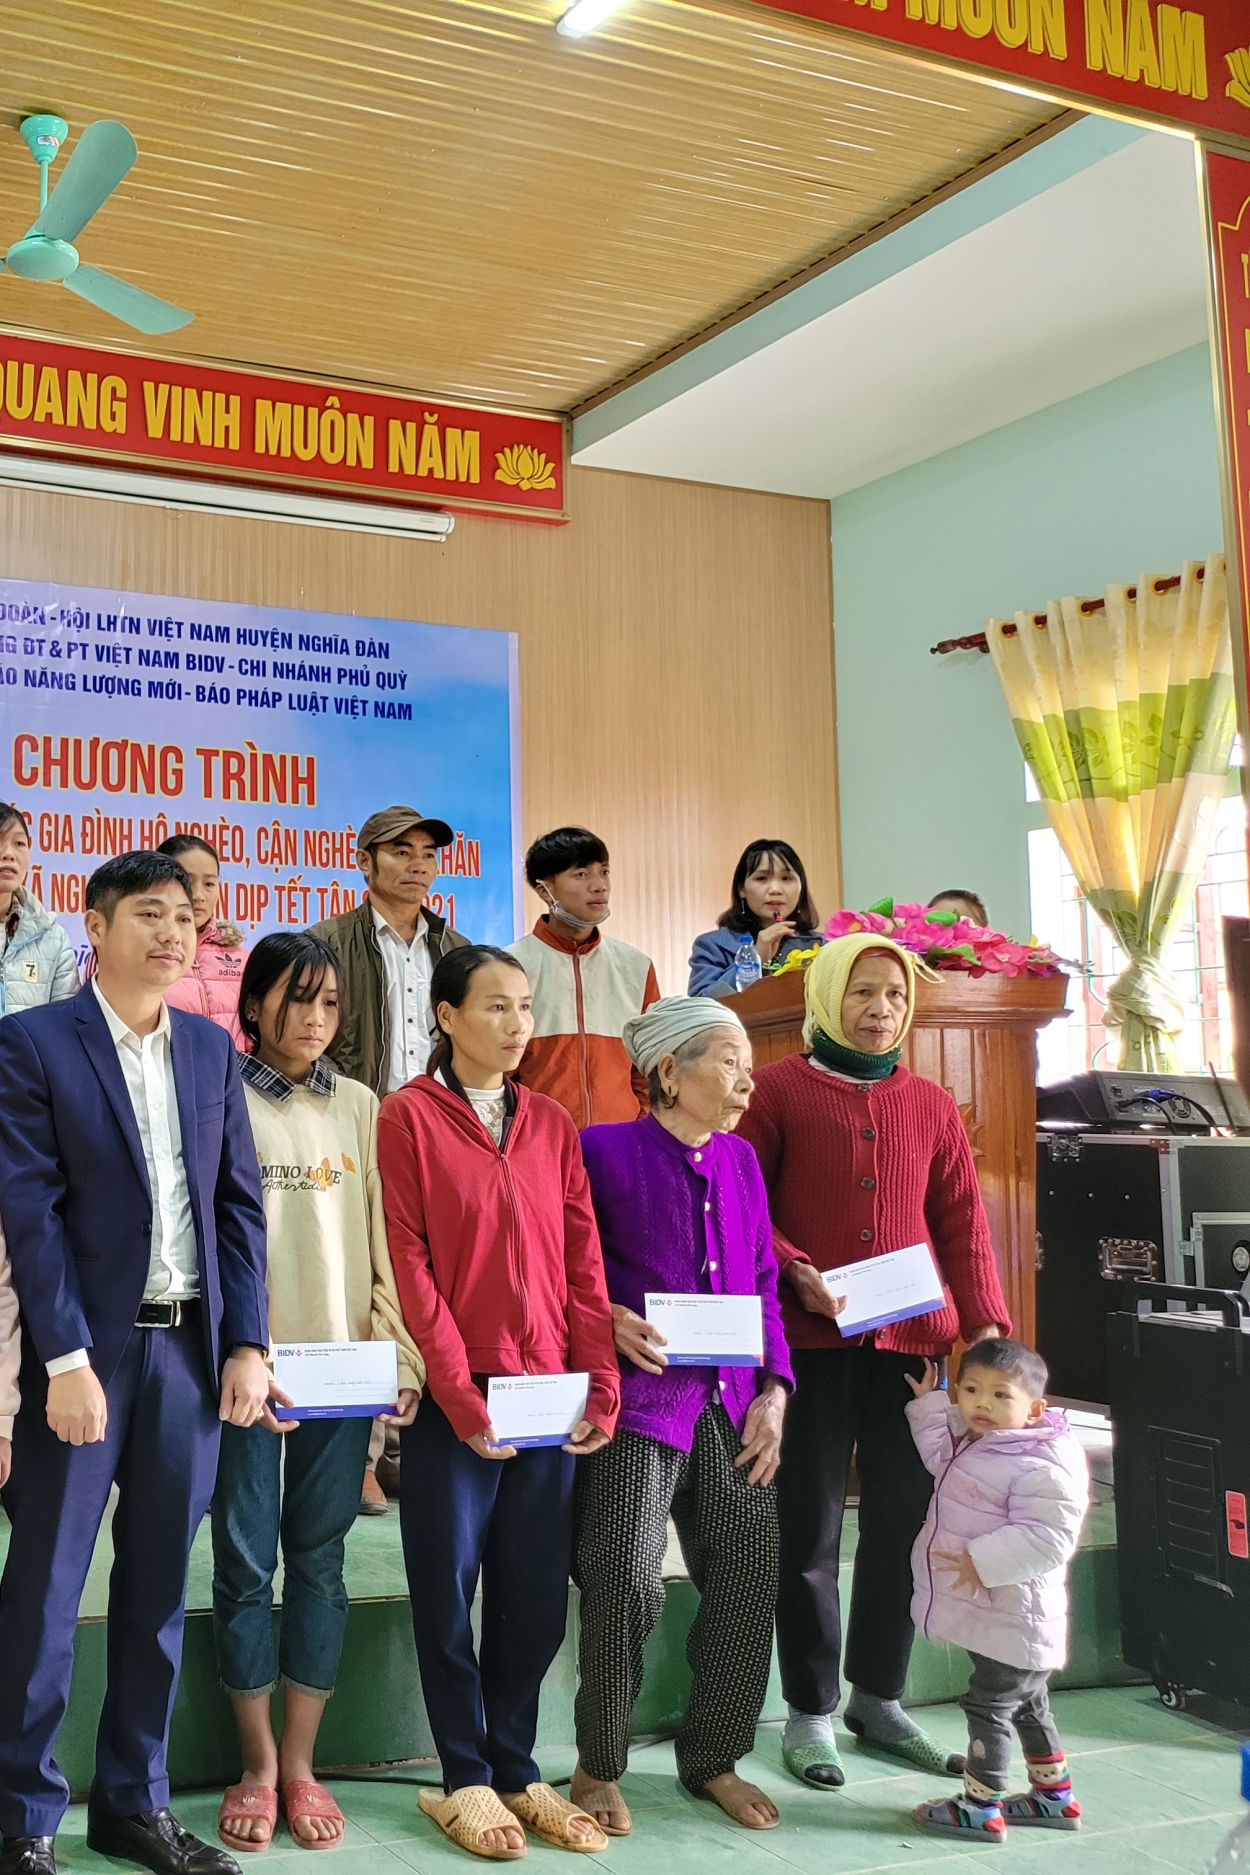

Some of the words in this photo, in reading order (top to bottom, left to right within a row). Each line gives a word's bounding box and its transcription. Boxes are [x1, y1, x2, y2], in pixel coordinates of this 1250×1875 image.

[142, 381, 241, 451] VINH
[254, 396, 374, 470] MUÔN
[387, 412, 481, 484] NĂM
[60, 607, 90, 632] HỘI
[97, 613, 140, 635] LHTN
[147, 617, 184, 642] VIỆT
[190, 622, 230, 644] NAM
[236, 627, 292, 652] HUYỆN
[298, 634, 350, 656] NGHĨA
[355, 637, 390, 660] ĐÀN
[49, 640, 63, 659] &
[66, 641, 89, 661] PT
[95, 643, 132, 668] VIỆT
[138, 648, 180, 669] NAM
[186, 653, 226, 674] BIDV
[238, 658, 266, 678] CHI
[272, 660, 331, 684] NHÁNH
[337, 664, 370, 687] PHỦ
[24, 666, 76, 691] NĂNG
[82, 674, 141, 699] LƯỢNG
[148, 679, 182, 701] MỚI
[195, 682, 230, 705] BÁO
[236, 687, 282, 709] PHÁP
[288, 691, 329, 716] LUẬT
[334, 695, 369, 719] VIỆT
[373, 701, 412, 721] NAM
[14, 734, 184, 797] CHƯƠNG
[196, 741, 316, 806] TRÌNH
[40, 812, 74, 854] GIA
[81, 808, 132, 856] ĐÌNH
[257, 820, 297, 873] CẬN
[304, 825, 358, 870] NGHÈ
[437, 832, 480, 877] HĂN
[236, 883, 269, 930] DỊP
[274, 875, 311, 925] TẾT
[316, 881, 355, 921] TÂN
[261, 1165, 301, 1179] MINO
[277, 1349, 295, 1357] BIDV
[492, 1383, 508, 1391] BIDV
